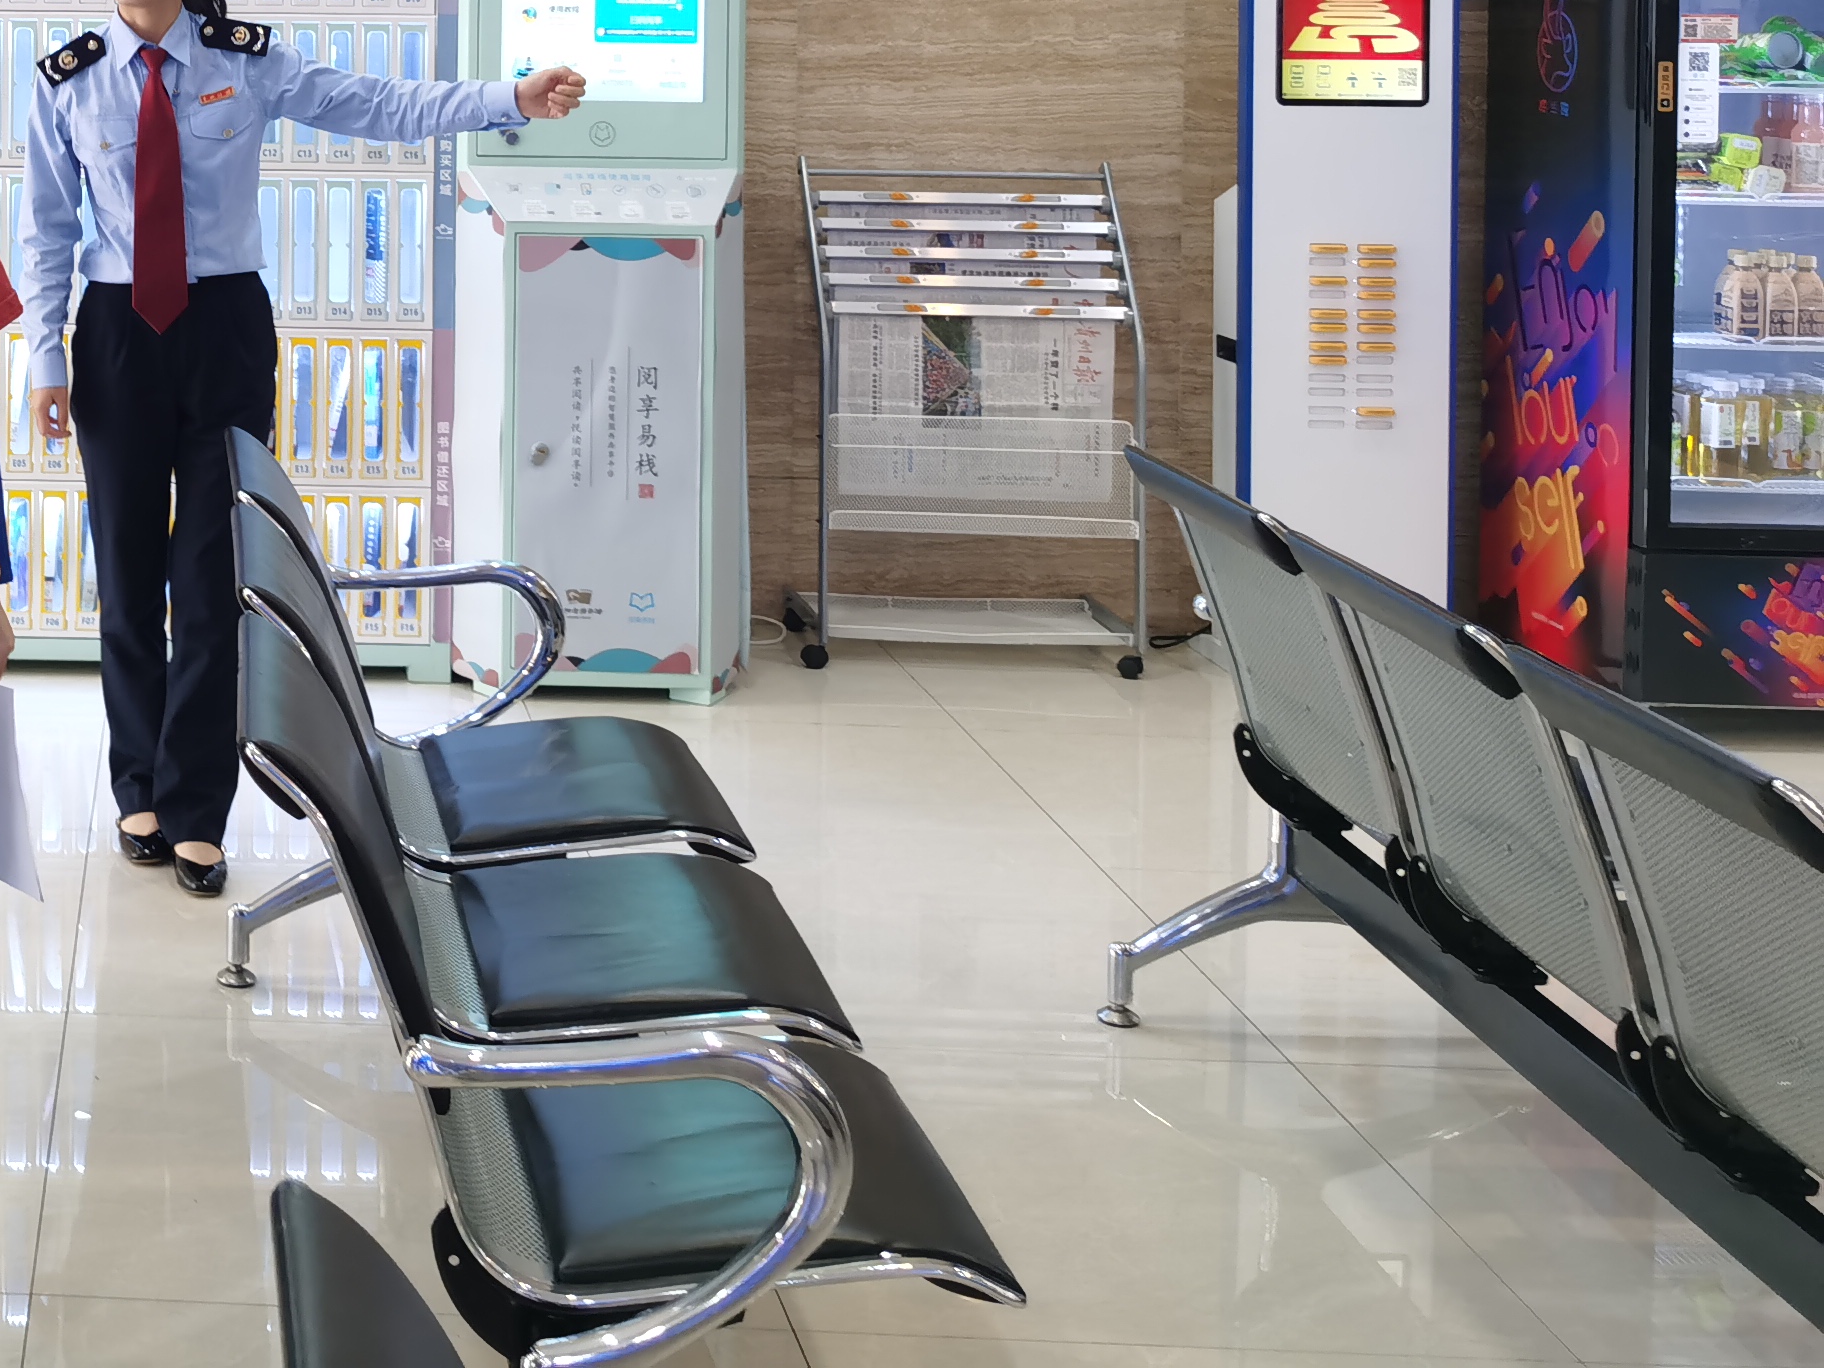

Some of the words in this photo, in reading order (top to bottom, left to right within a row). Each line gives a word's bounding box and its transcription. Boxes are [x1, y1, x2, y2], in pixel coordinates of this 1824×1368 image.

[16, 145, 26, 154] C0
[262, 148, 277, 157] C12
[296, 149, 312, 158] C13
[333, 150, 349, 158] C14
[367, 151, 383, 159] C15
[403, 151, 419, 160] C16
[296, 307, 312, 315] D13
[331, 308, 347, 316] D14
[366, 308, 383, 316] D15
[402, 308, 419, 317] D16
[635, 366, 659, 477] 阅享易栈
[12, 459, 27, 468] E05
[47, 460, 62, 469] E06
[294, 464, 310, 473] E13
[330, 465, 345, 474] E14
[366, 465, 381, 474] E15
[401, 466, 417, 475] E16
